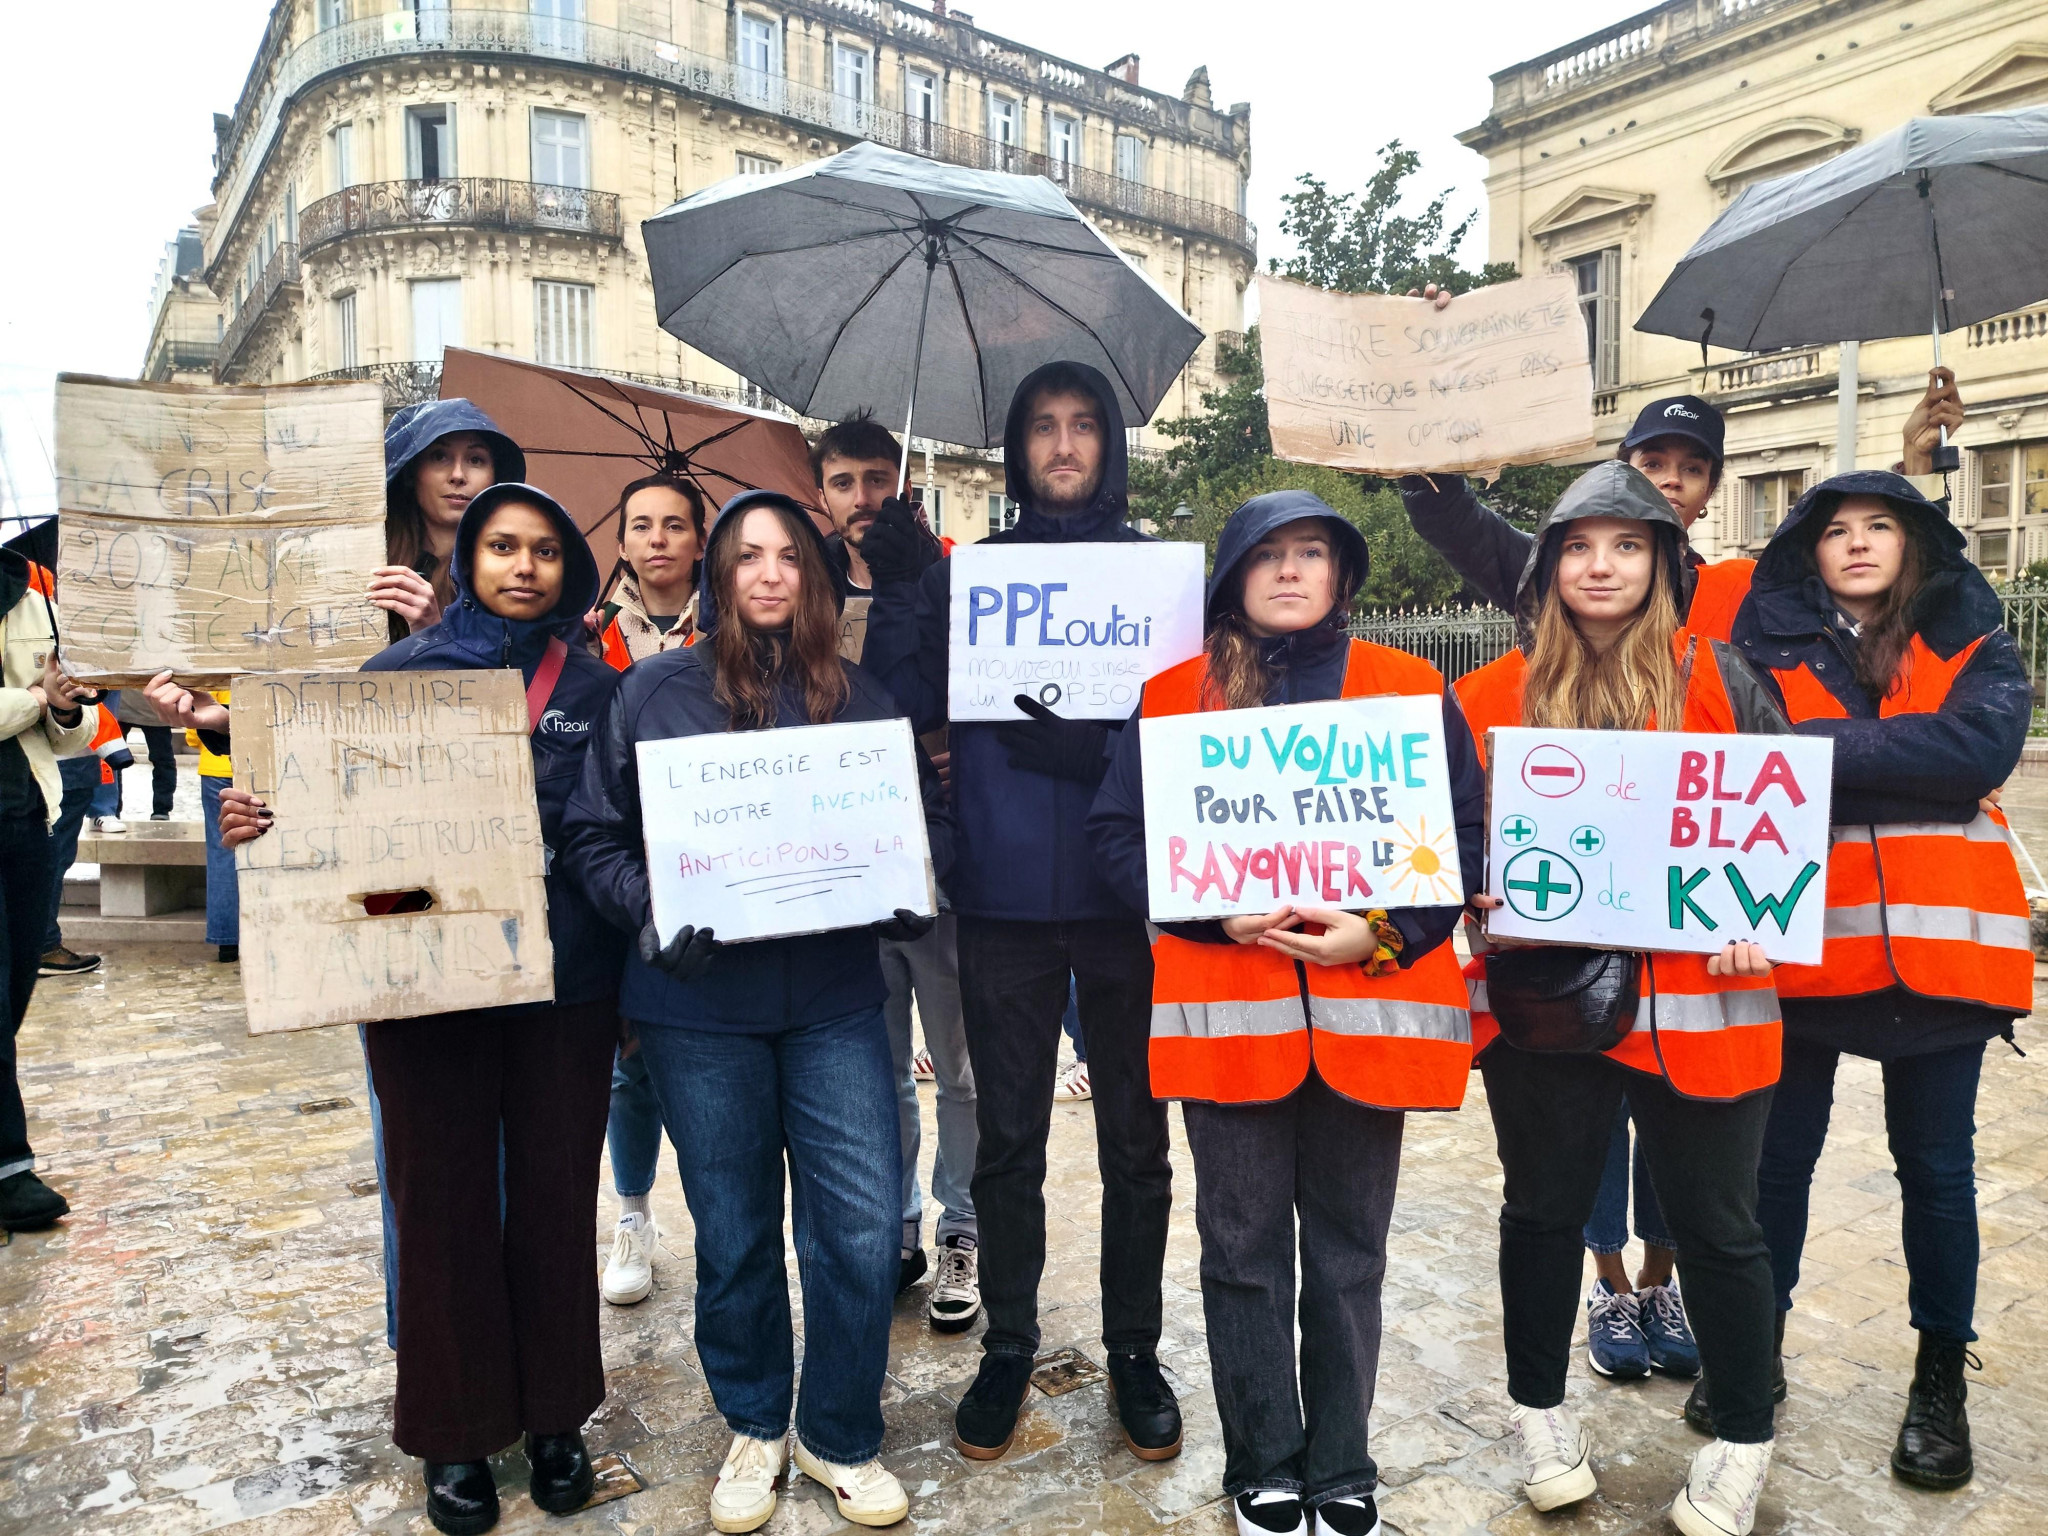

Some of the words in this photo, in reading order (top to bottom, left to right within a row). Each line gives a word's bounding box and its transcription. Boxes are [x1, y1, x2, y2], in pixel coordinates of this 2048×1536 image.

[1329, 417, 1375, 449] UNE
[157, 468, 282, 516] CRISE
[262, 674, 480, 729] DÉTRUIRE
[969, 684, 999, 709] du
[246, 751, 310, 795] LA
[839, 748, 887, 768] EST
[1200, 733, 1251, 770] DU
[1260, 723, 1430, 788] VOLUME
[1605, 754, 1641, 800] de
[1676, 750, 1807, 808] BLA
[693, 802, 773, 827] NOTRE
[812, 781, 908, 813] AVENIR,
[1194, 785, 1277, 824] POUR
[1293, 785, 1394, 825] FAIRE
[366, 811, 531, 865] DÉTRUIRE
[1670, 806, 1790, 856] BLA
[679, 841, 850, 878] ANTICIPONS
[875, 835, 904, 854] LA
[1168, 835, 1373, 903] RAYONNER
[1372, 840, 1394, 867] LE
[1598, 861, 1634, 912] de
[1667, 860, 1821, 936] KW
